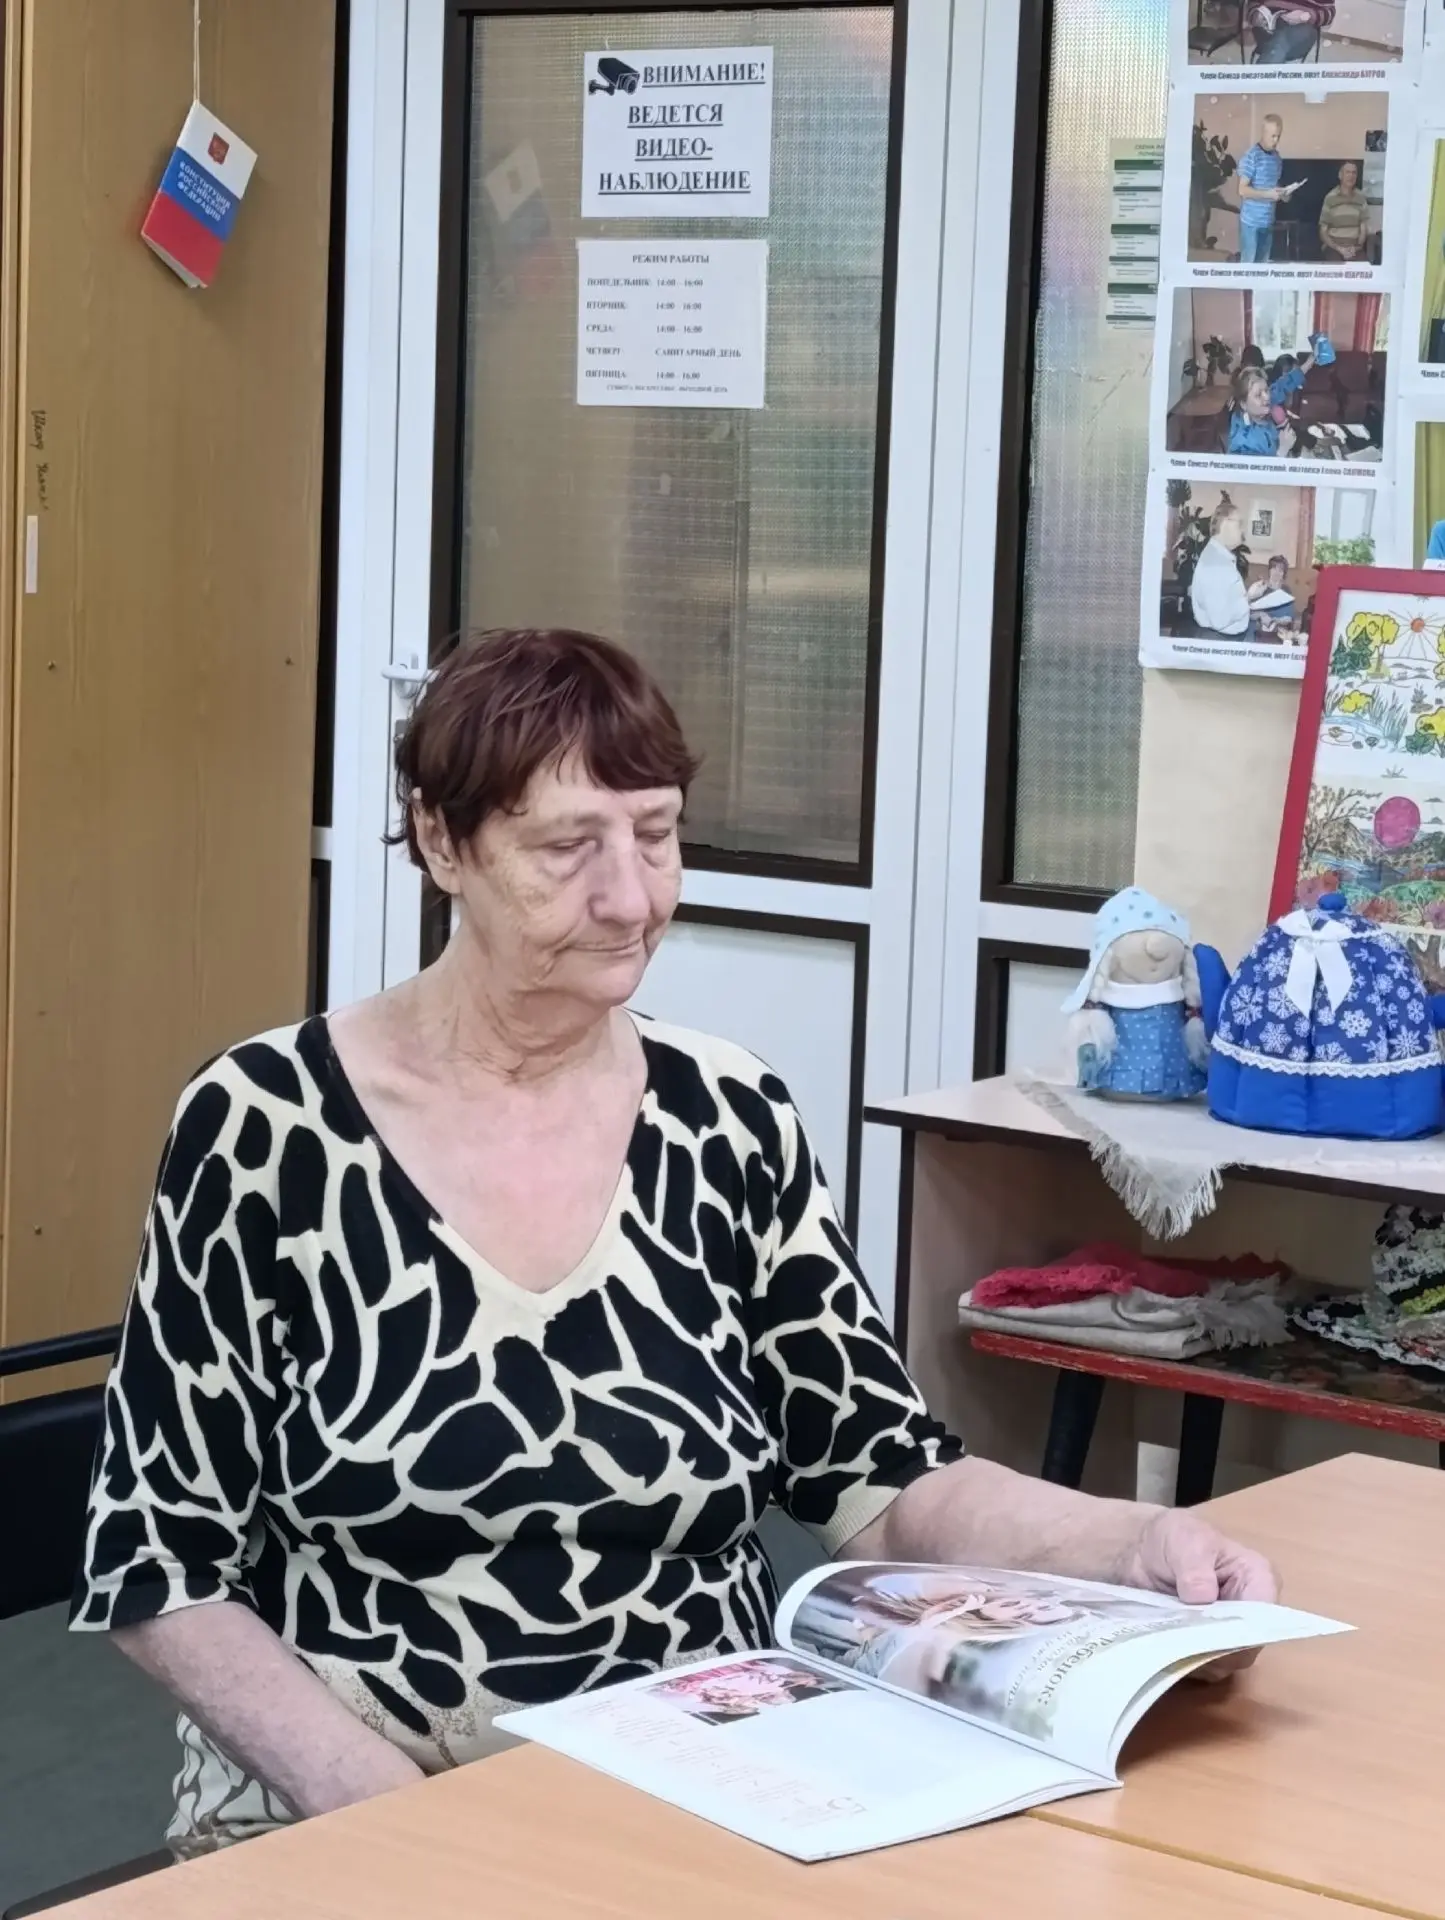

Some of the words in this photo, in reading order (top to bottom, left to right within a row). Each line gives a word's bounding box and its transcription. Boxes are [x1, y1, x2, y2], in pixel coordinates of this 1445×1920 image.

[643, 63, 766, 84] ВНИМАНИЕ!
[628, 103, 724, 126] ВЕДЕТСЯ
[635, 137, 714, 159] ВИДЕО-
[178, 161, 231, 210] КОНСТИТУЦИЯ
[599, 170, 751, 192] НАБЛЮДЕНИЕ
[176, 181, 222, 222] ФЕДЕРАЦИИ
[178, 171, 226, 216] РОССИЙСКОЙ
[632, 254, 668, 264] РЕЖИМ
[669, 254, 710, 264] РАБОТЫ
[716, 348, 742, 358] ДЕНЬ
